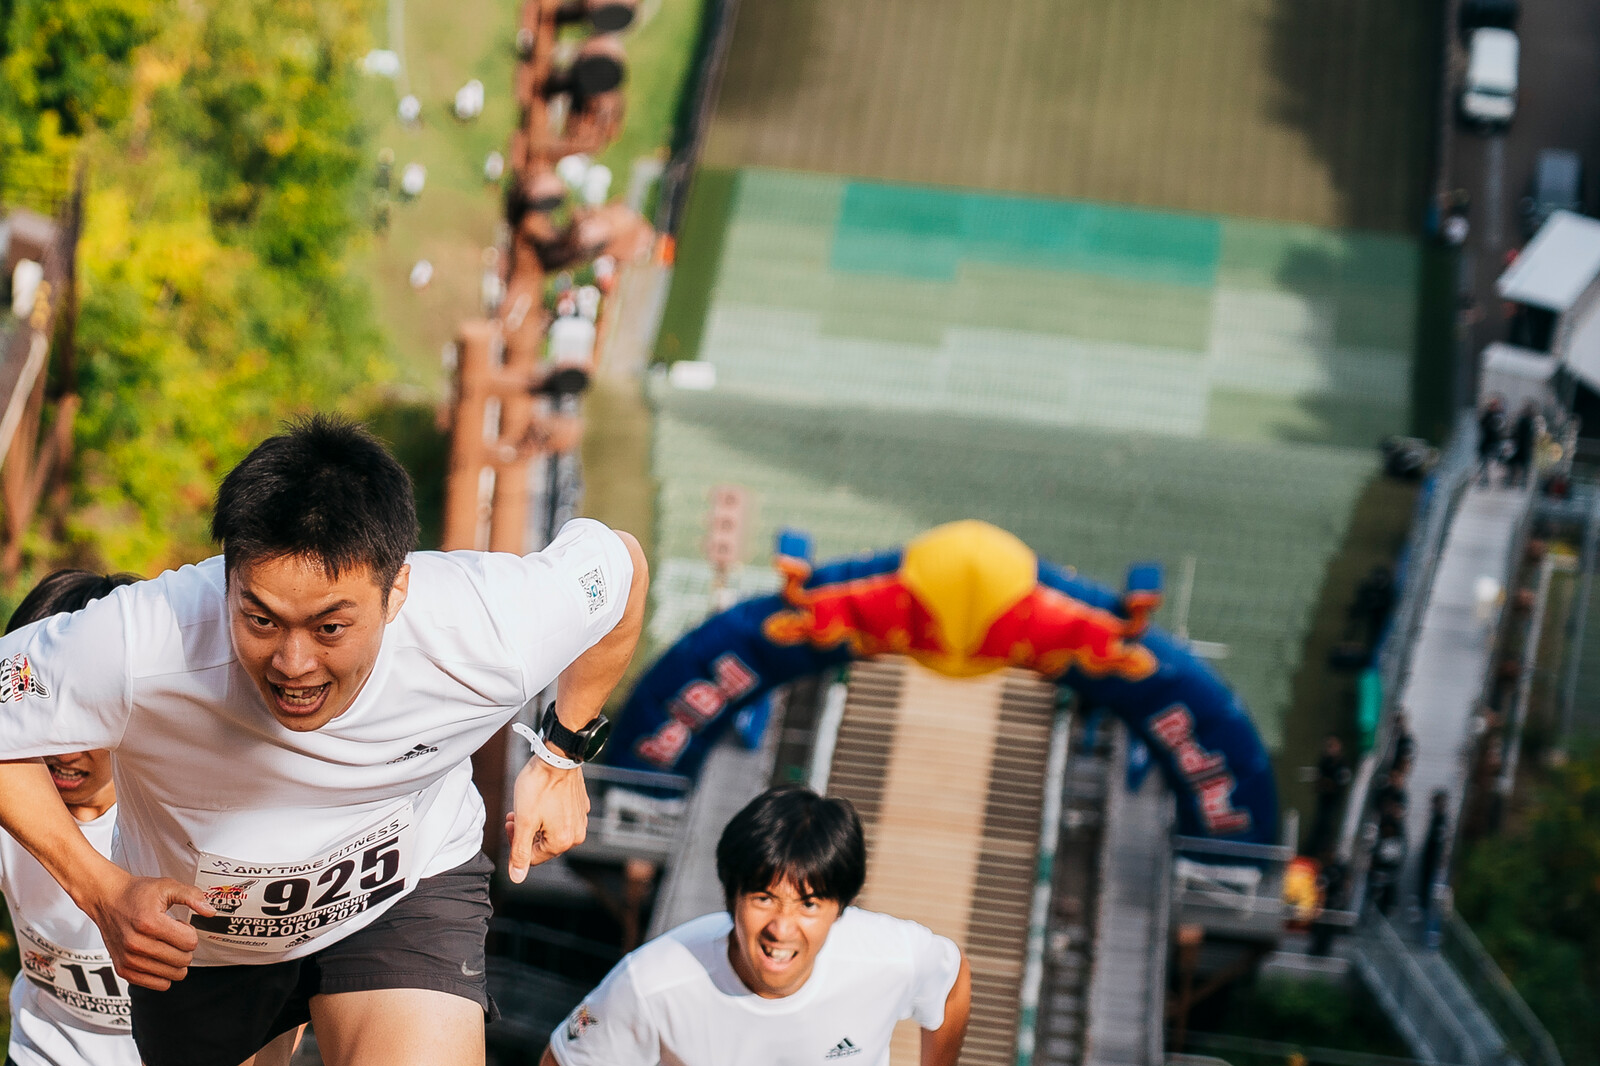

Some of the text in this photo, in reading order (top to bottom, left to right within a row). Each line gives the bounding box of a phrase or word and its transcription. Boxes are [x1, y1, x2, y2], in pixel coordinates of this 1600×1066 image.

[233, 819, 400, 875] ANYTIME FITNESS
[261, 836, 400, 916] 925
[227, 901, 368, 937] SAPPORO 2021
[230, 892, 372, 927] WORLD CHAMPIONSHIP
[56, 991, 132, 1016] SAPPORO
